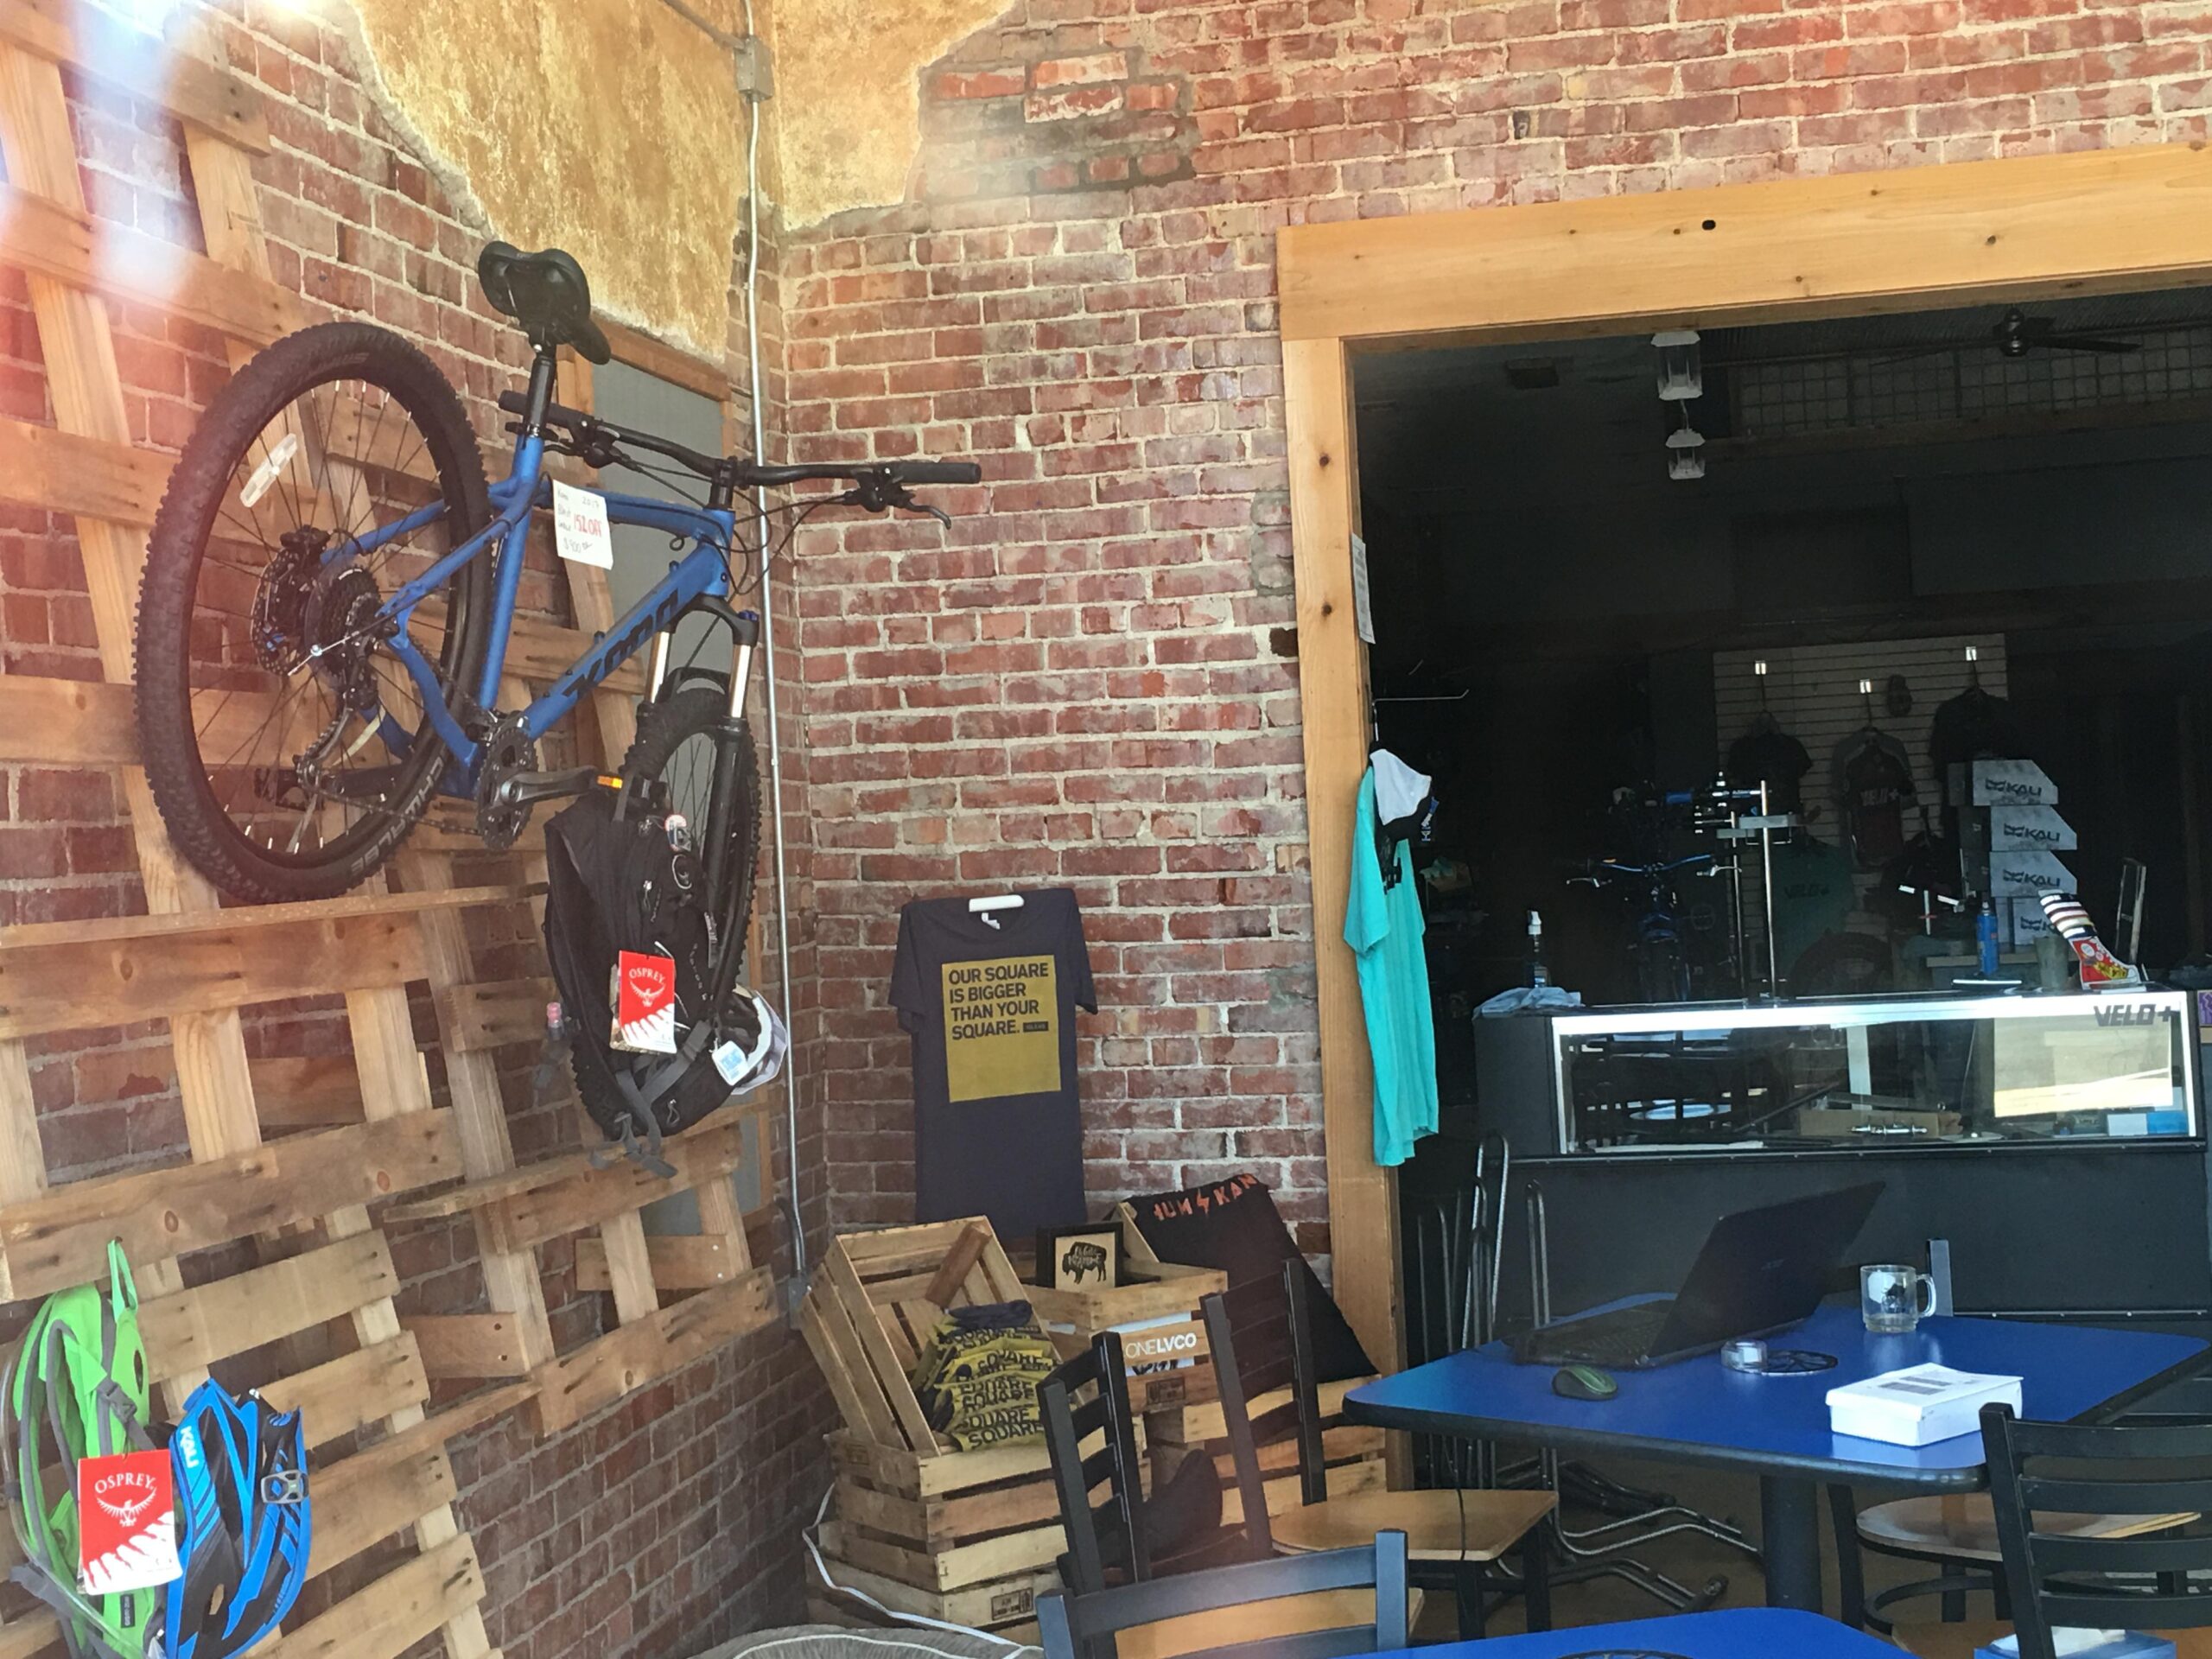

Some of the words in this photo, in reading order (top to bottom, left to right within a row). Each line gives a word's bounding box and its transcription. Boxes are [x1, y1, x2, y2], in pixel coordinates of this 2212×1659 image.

[2006, 782, 2042, 796] KALI
[2025, 828, 2060, 842] KALI
[2024, 874, 2060, 887] KALI
[629, 967, 665, 983] OSPREY
[949, 969, 982, 985] OUR
[985, 963, 1048, 982] SQUARE
[950, 988, 964, 1003] IS
[968, 982, 1026, 1001] BIGGER
[951, 1004, 993, 1021] THAN
[997, 1000, 1039, 1016] YOUR
[952, 1020, 1020, 1040] SQUARE.
[94, 1472, 156, 1493] OSPREY
